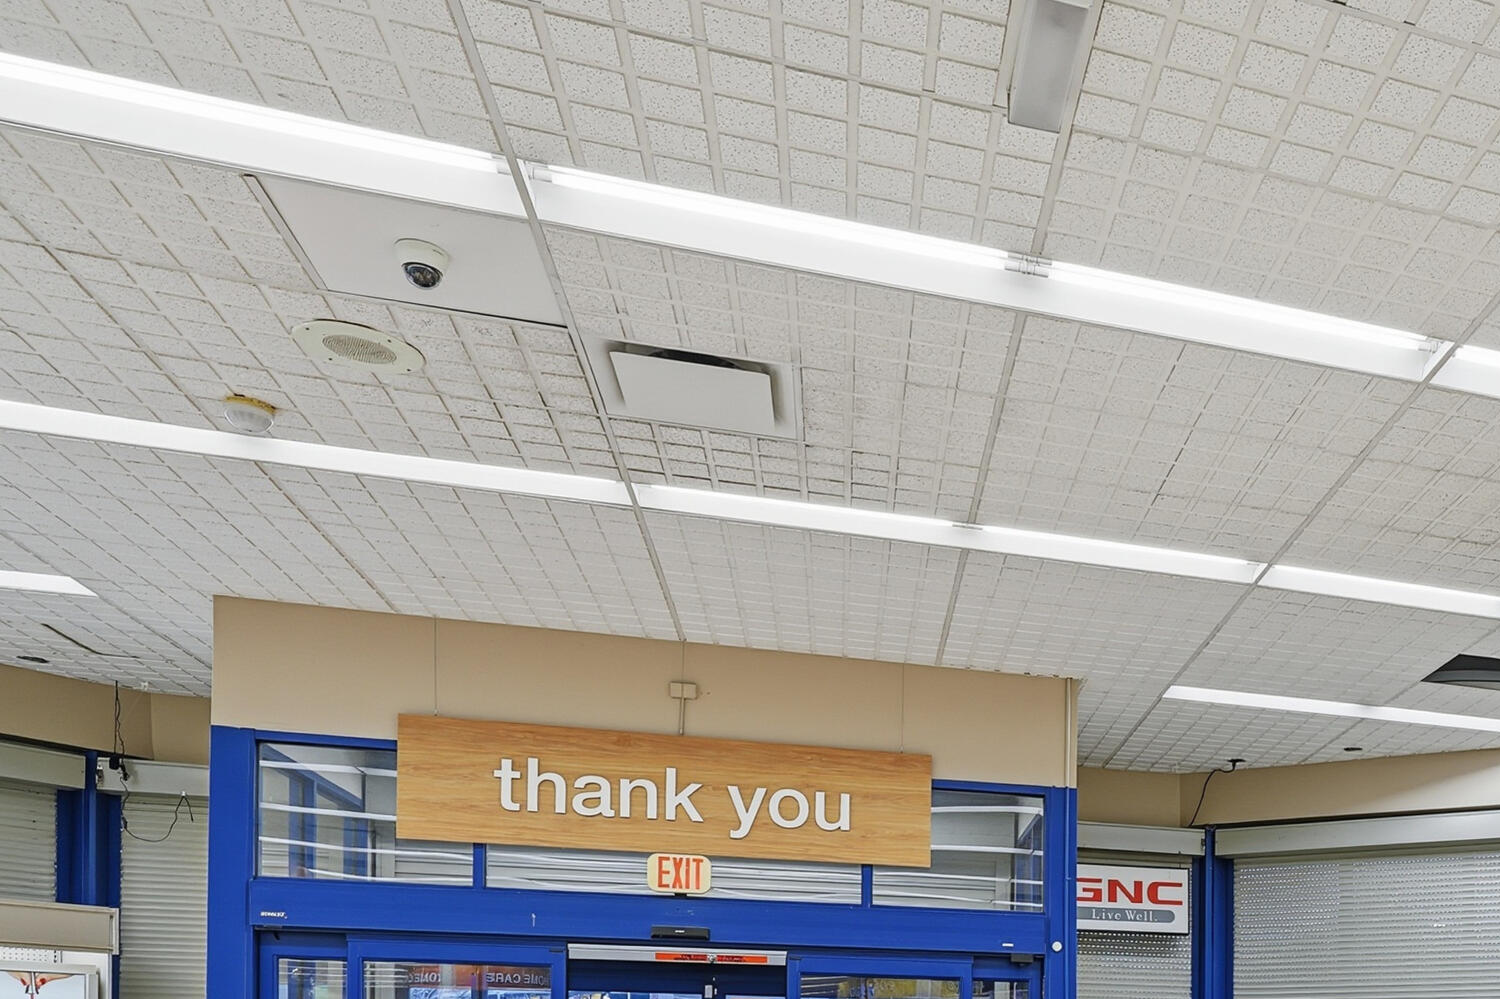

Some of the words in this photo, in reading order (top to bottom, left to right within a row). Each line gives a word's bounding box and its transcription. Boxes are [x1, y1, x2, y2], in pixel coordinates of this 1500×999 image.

[493, 757, 704, 822] thank
[727, 784, 851, 839] you
[657, 855, 704, 890] EXIT
[1077, 878, 1183, 905] GNC
[1092, 909, 1121, 919] Live
[1125, 910, 1158, 922] Well.
